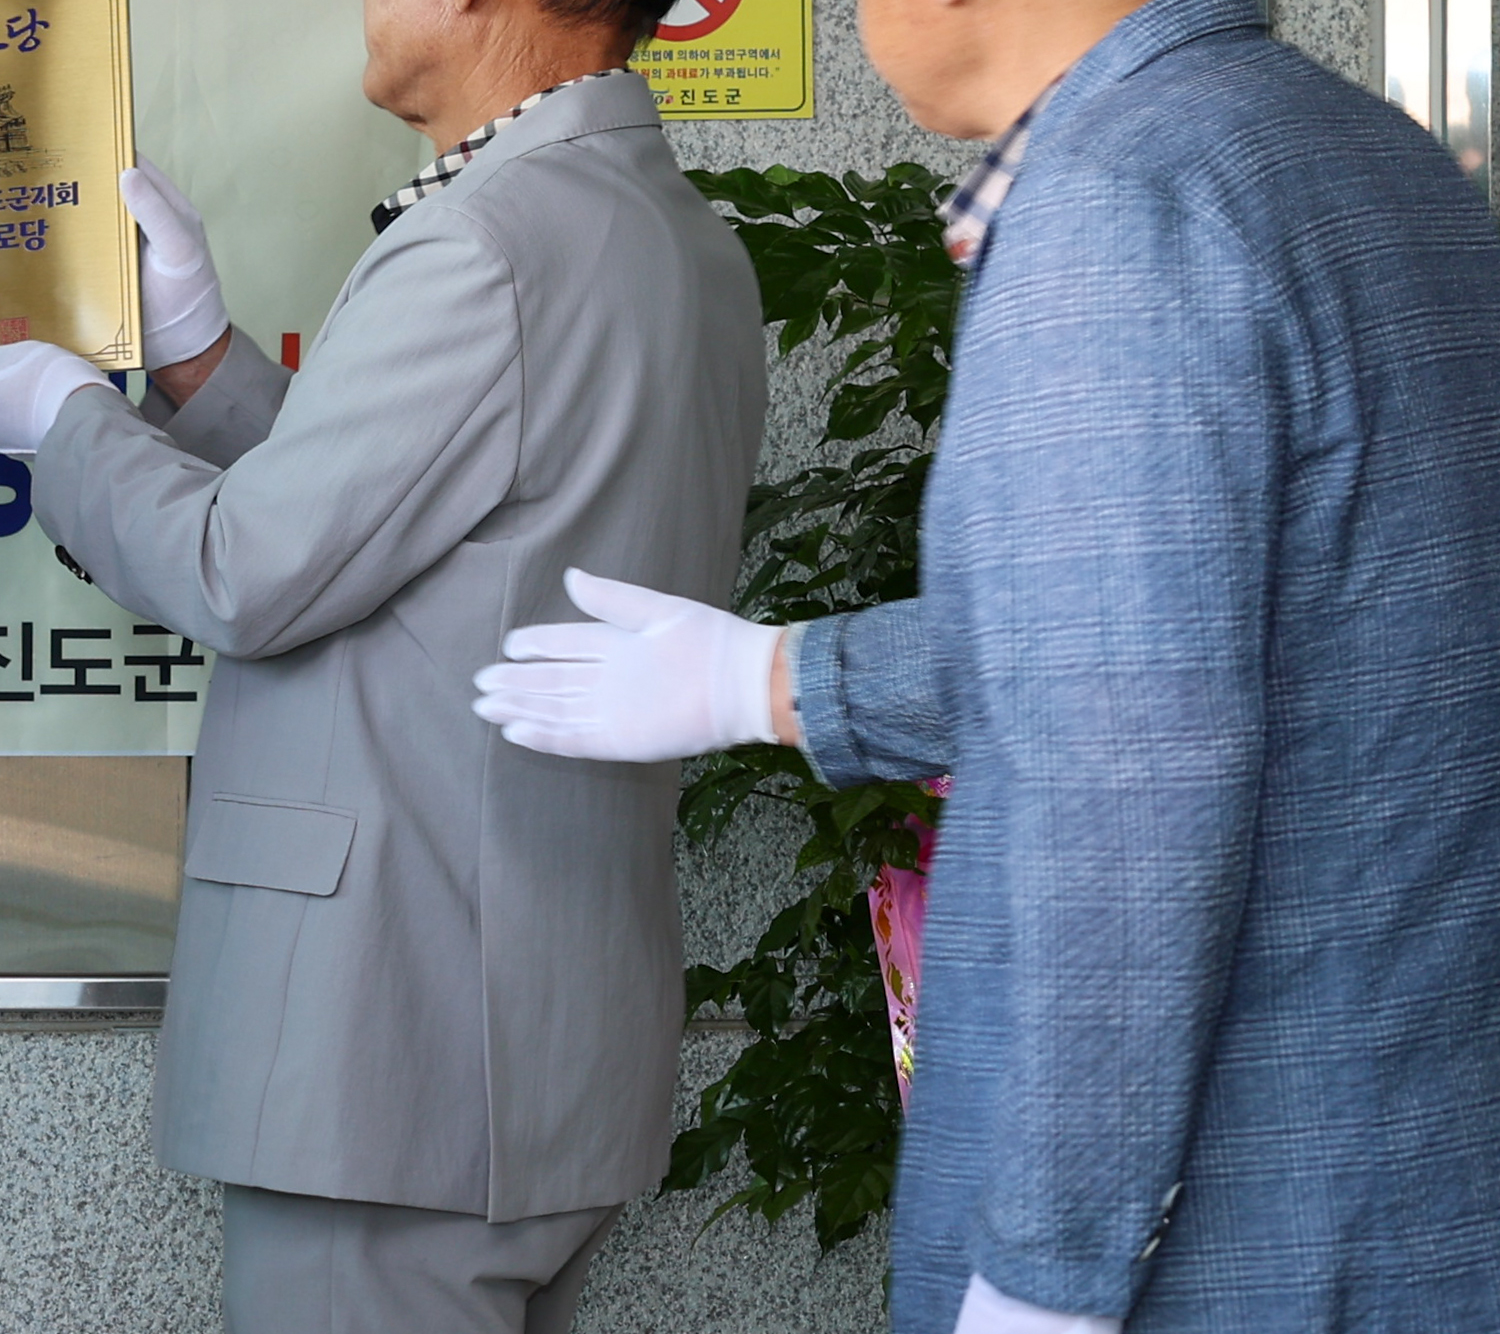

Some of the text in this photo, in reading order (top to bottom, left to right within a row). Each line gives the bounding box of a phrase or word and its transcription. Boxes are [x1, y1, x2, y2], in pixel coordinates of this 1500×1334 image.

[677, 49, 710, 62] 의하여
[713, 48, 781, 61] 금연구역에서
[666, 68, 710, 80] 과태료가
